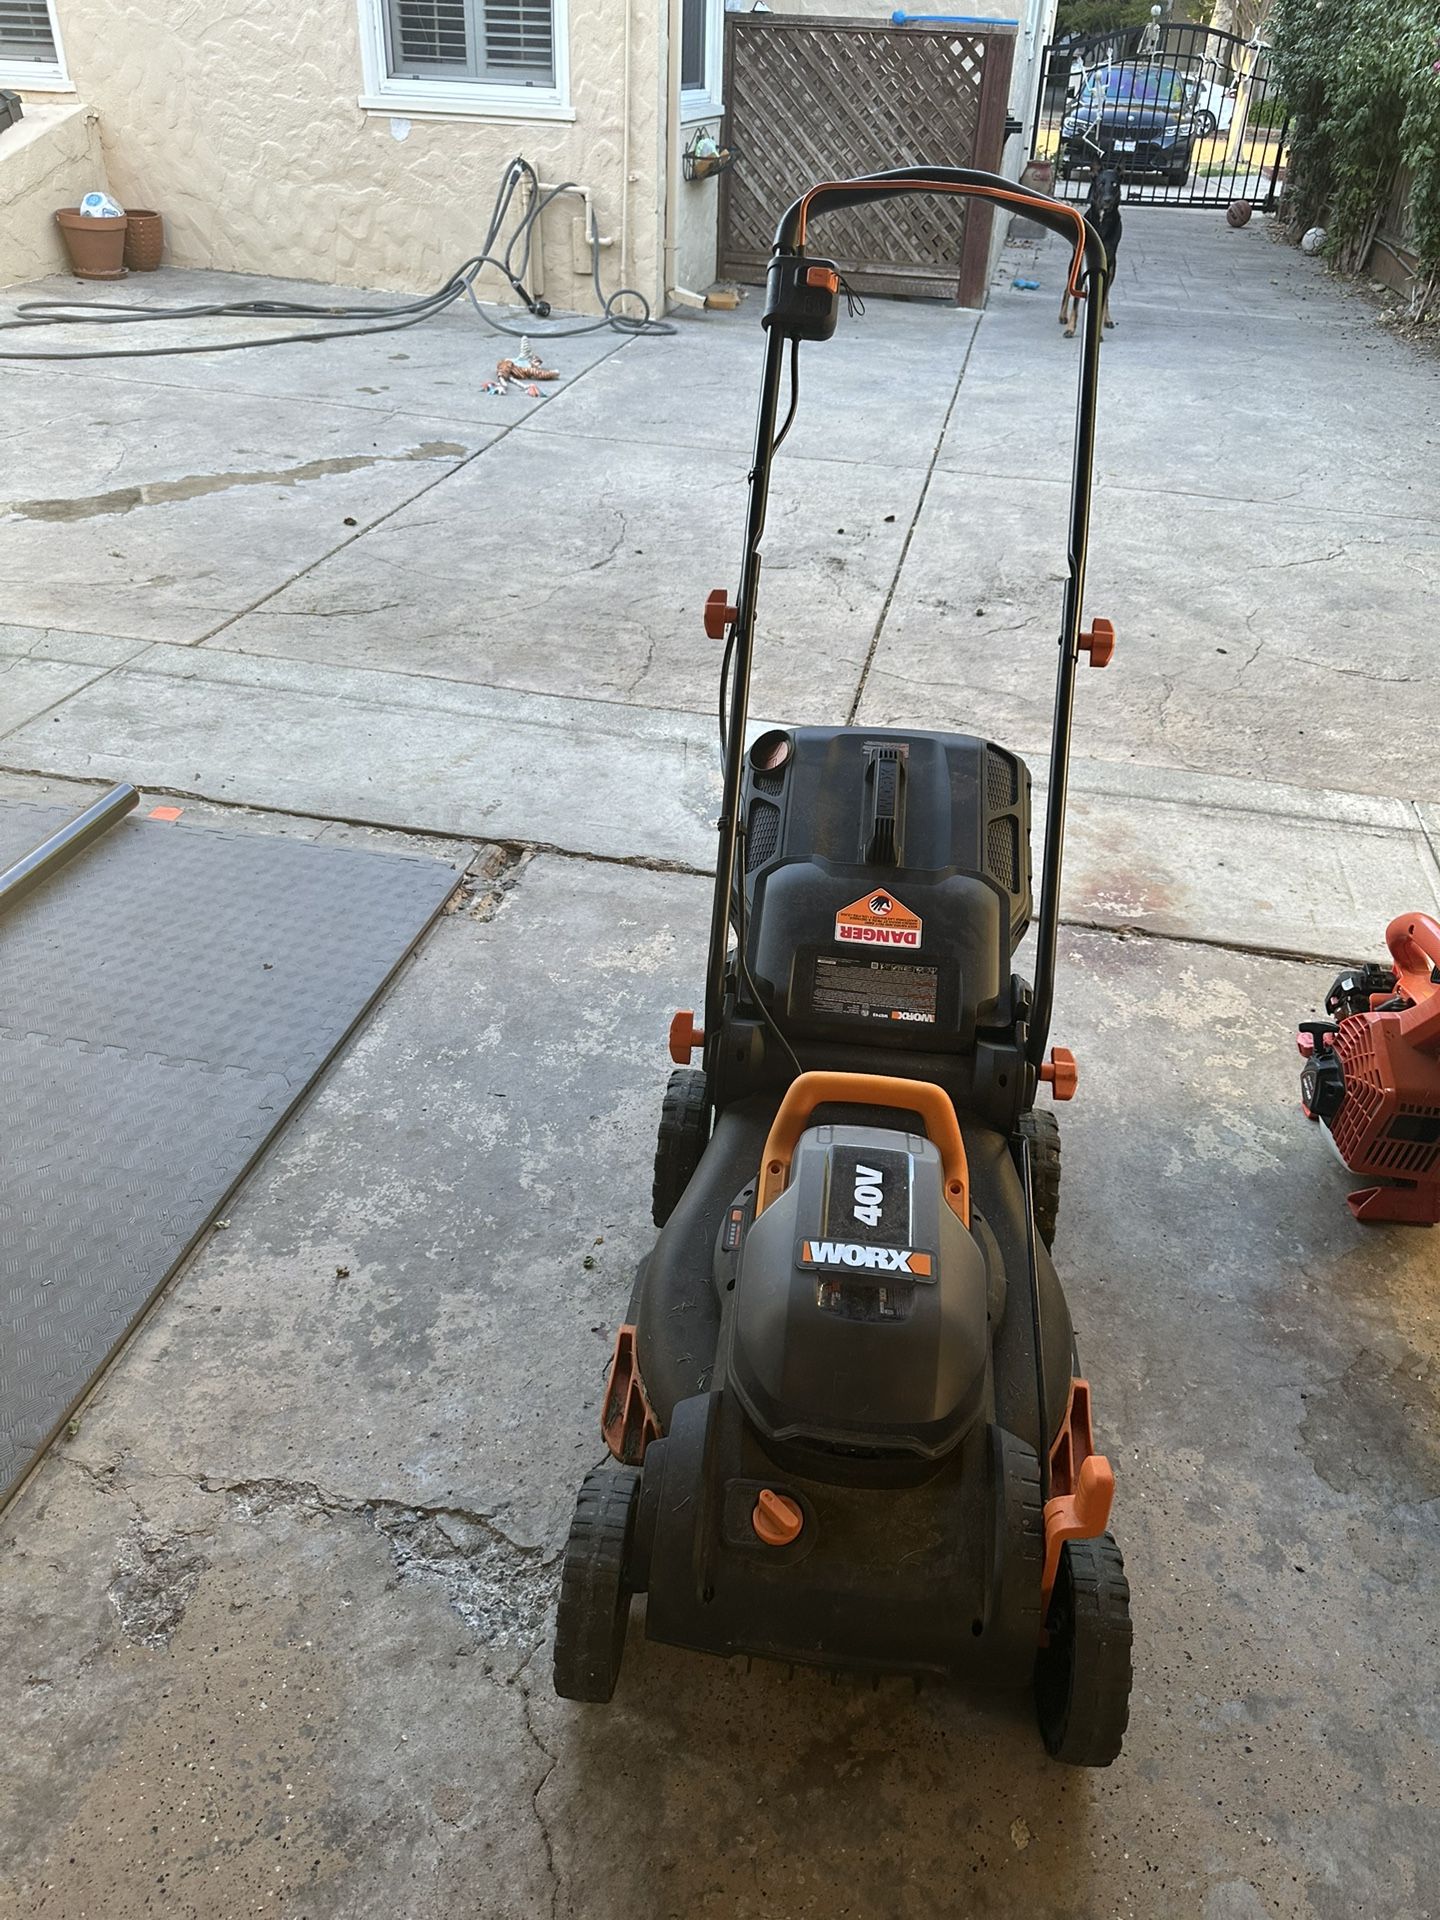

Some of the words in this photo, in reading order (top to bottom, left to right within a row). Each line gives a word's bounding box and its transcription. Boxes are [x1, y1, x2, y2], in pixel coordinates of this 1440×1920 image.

[840, 925, 917, 945] DANGER
[897, 1010, 935, 1023] WORX
[853, 1164, 884, 1227] 40V
[809, 1241, 913, 1273] WORX
